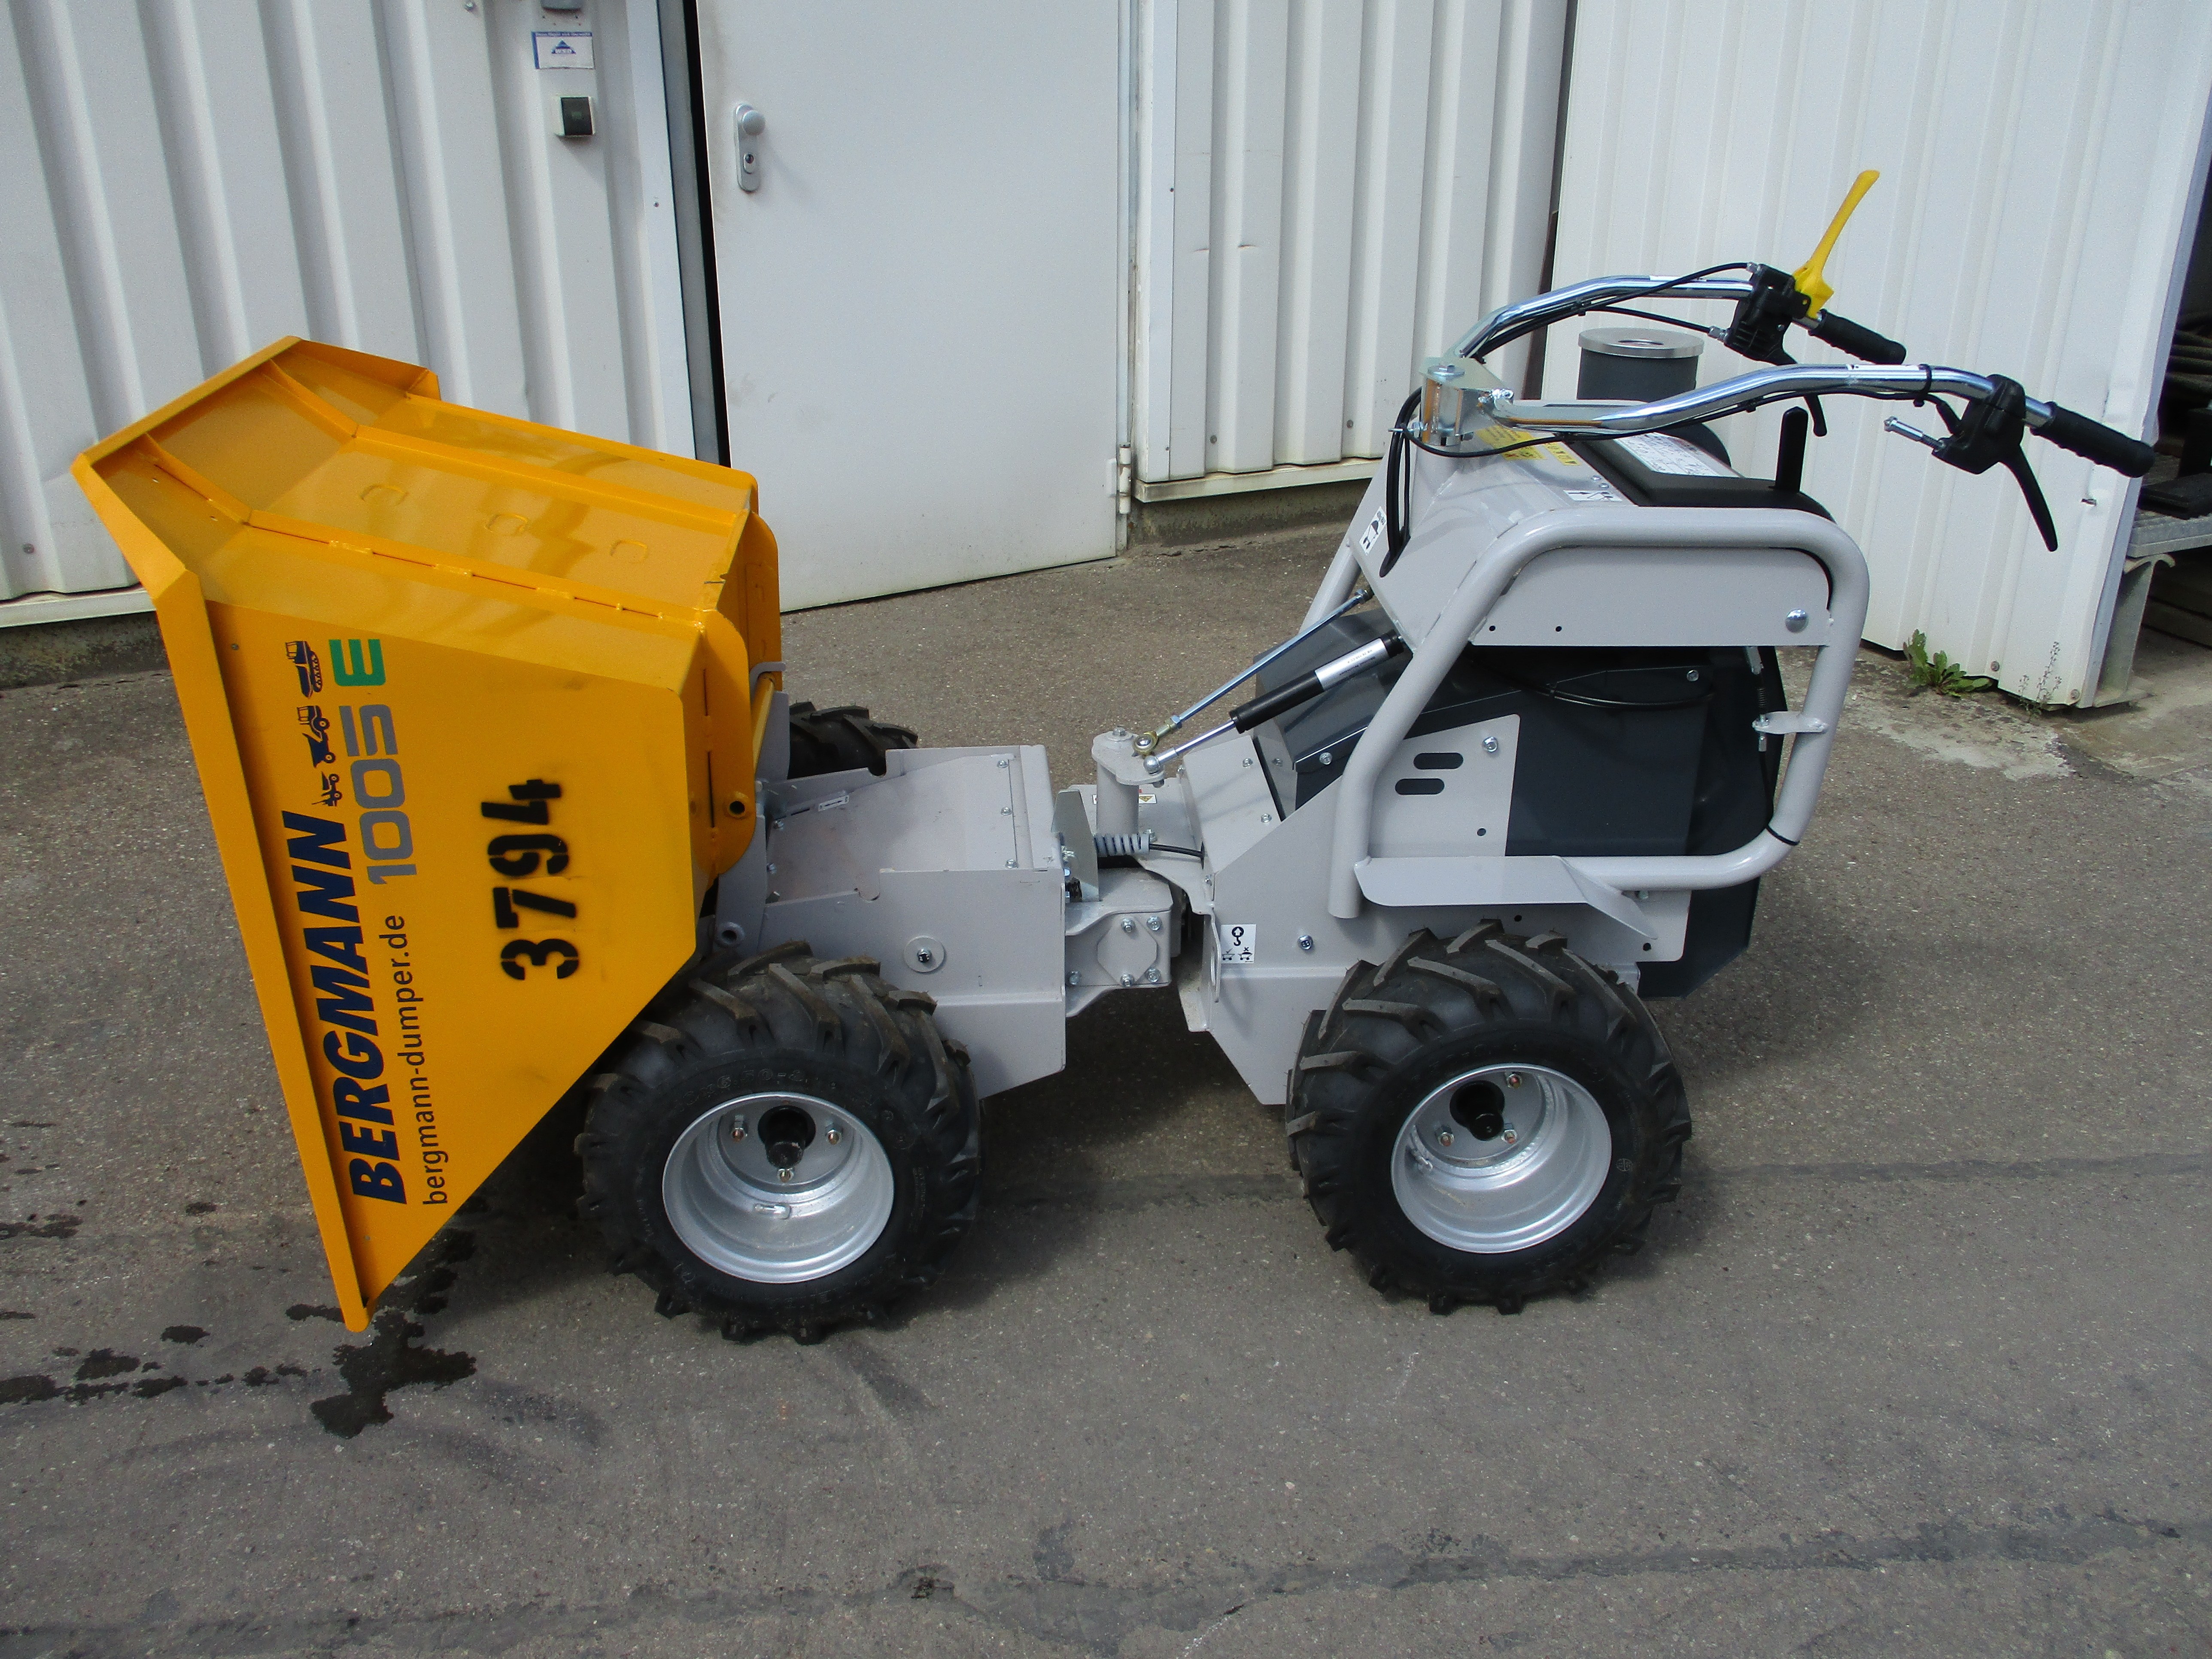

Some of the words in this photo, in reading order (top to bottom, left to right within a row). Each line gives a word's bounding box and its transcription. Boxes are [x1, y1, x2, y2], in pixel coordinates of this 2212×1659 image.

[282, 810, 407, 1204] BERGMANN
[481, 780, 579, 980] 3794
[379, 915, 449, 1204] bergmann-dumper.de
